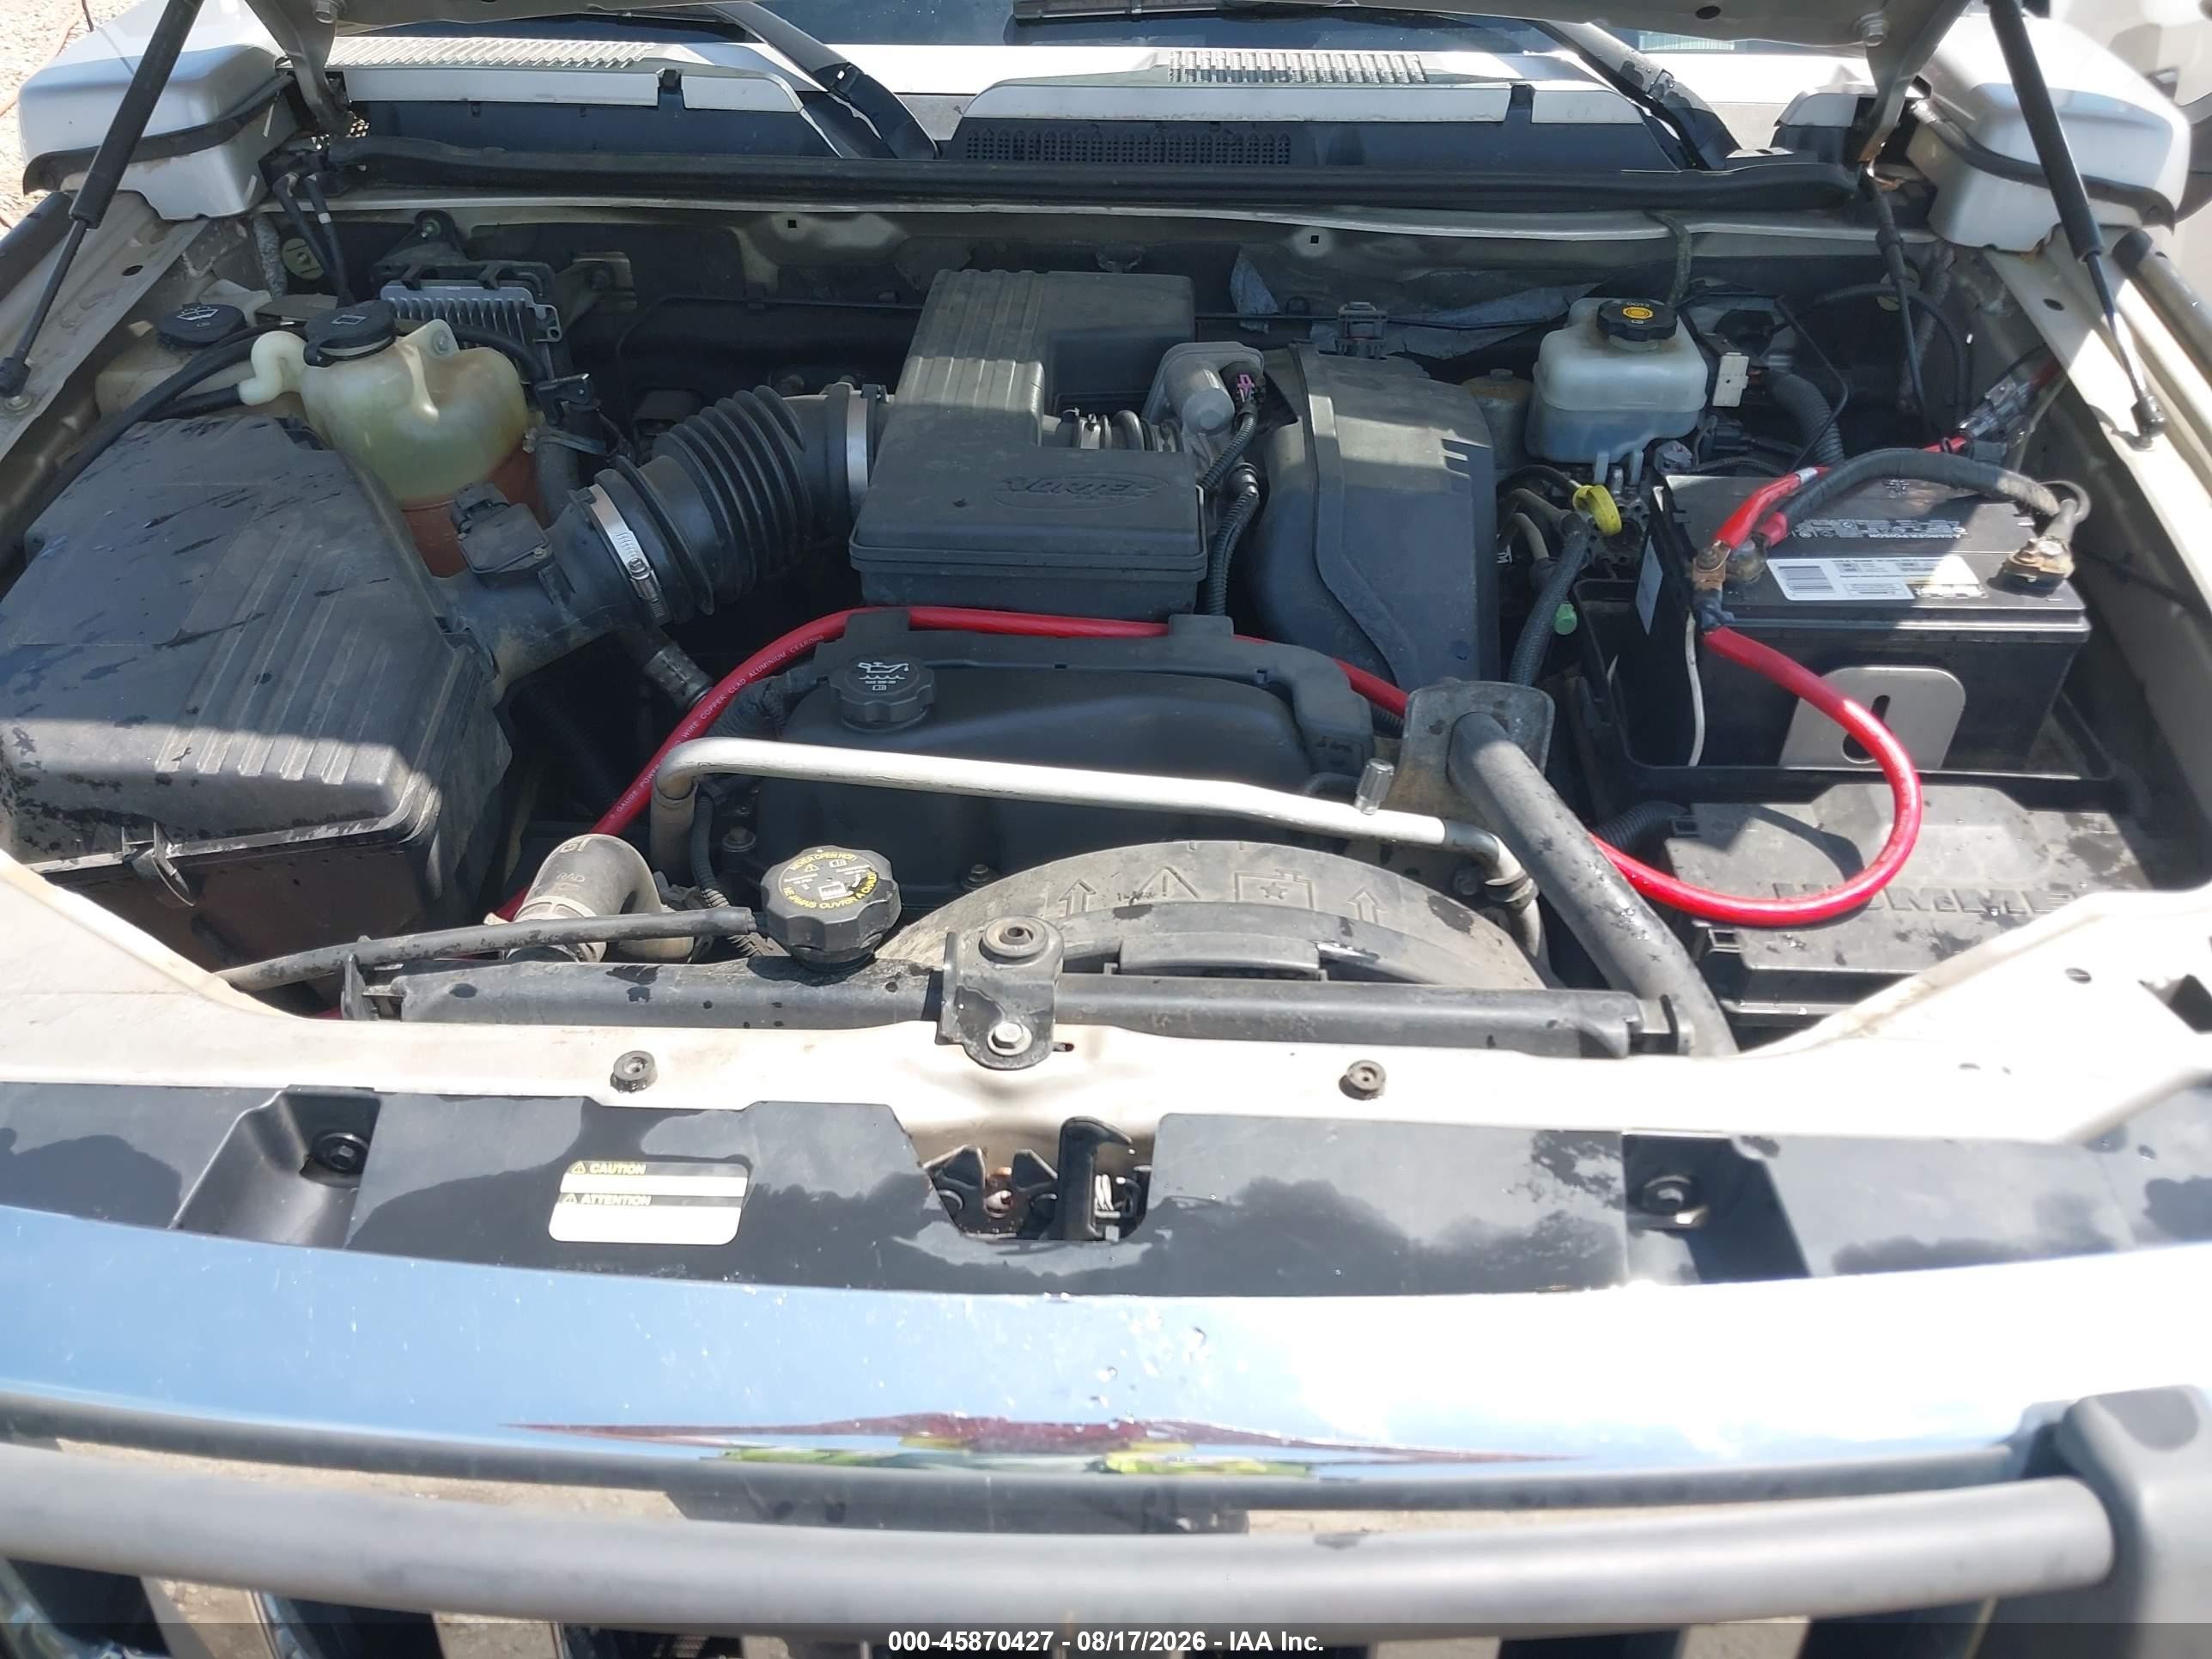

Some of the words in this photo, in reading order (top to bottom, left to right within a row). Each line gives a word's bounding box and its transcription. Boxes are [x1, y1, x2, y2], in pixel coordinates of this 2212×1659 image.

[617, 790, 639, 812] GAUGE
[681, 720, 701, 738] WIRE
[700, 694, 727, 720] COPPER
[727, 678, 747, 695] CLAD
[748, 652, 787, 678] ALUMINIUM
[790, 855, 815, 872] NEVER
[814, 851, 838, 860] OPEN
[789, 894, 817, 908] JAMAIS
[819, 896, 859, 908] OUVRIR
[590, 1162, 647, 1176] CAUTION
[580, 1193, 652, 1206] ATTENTION
